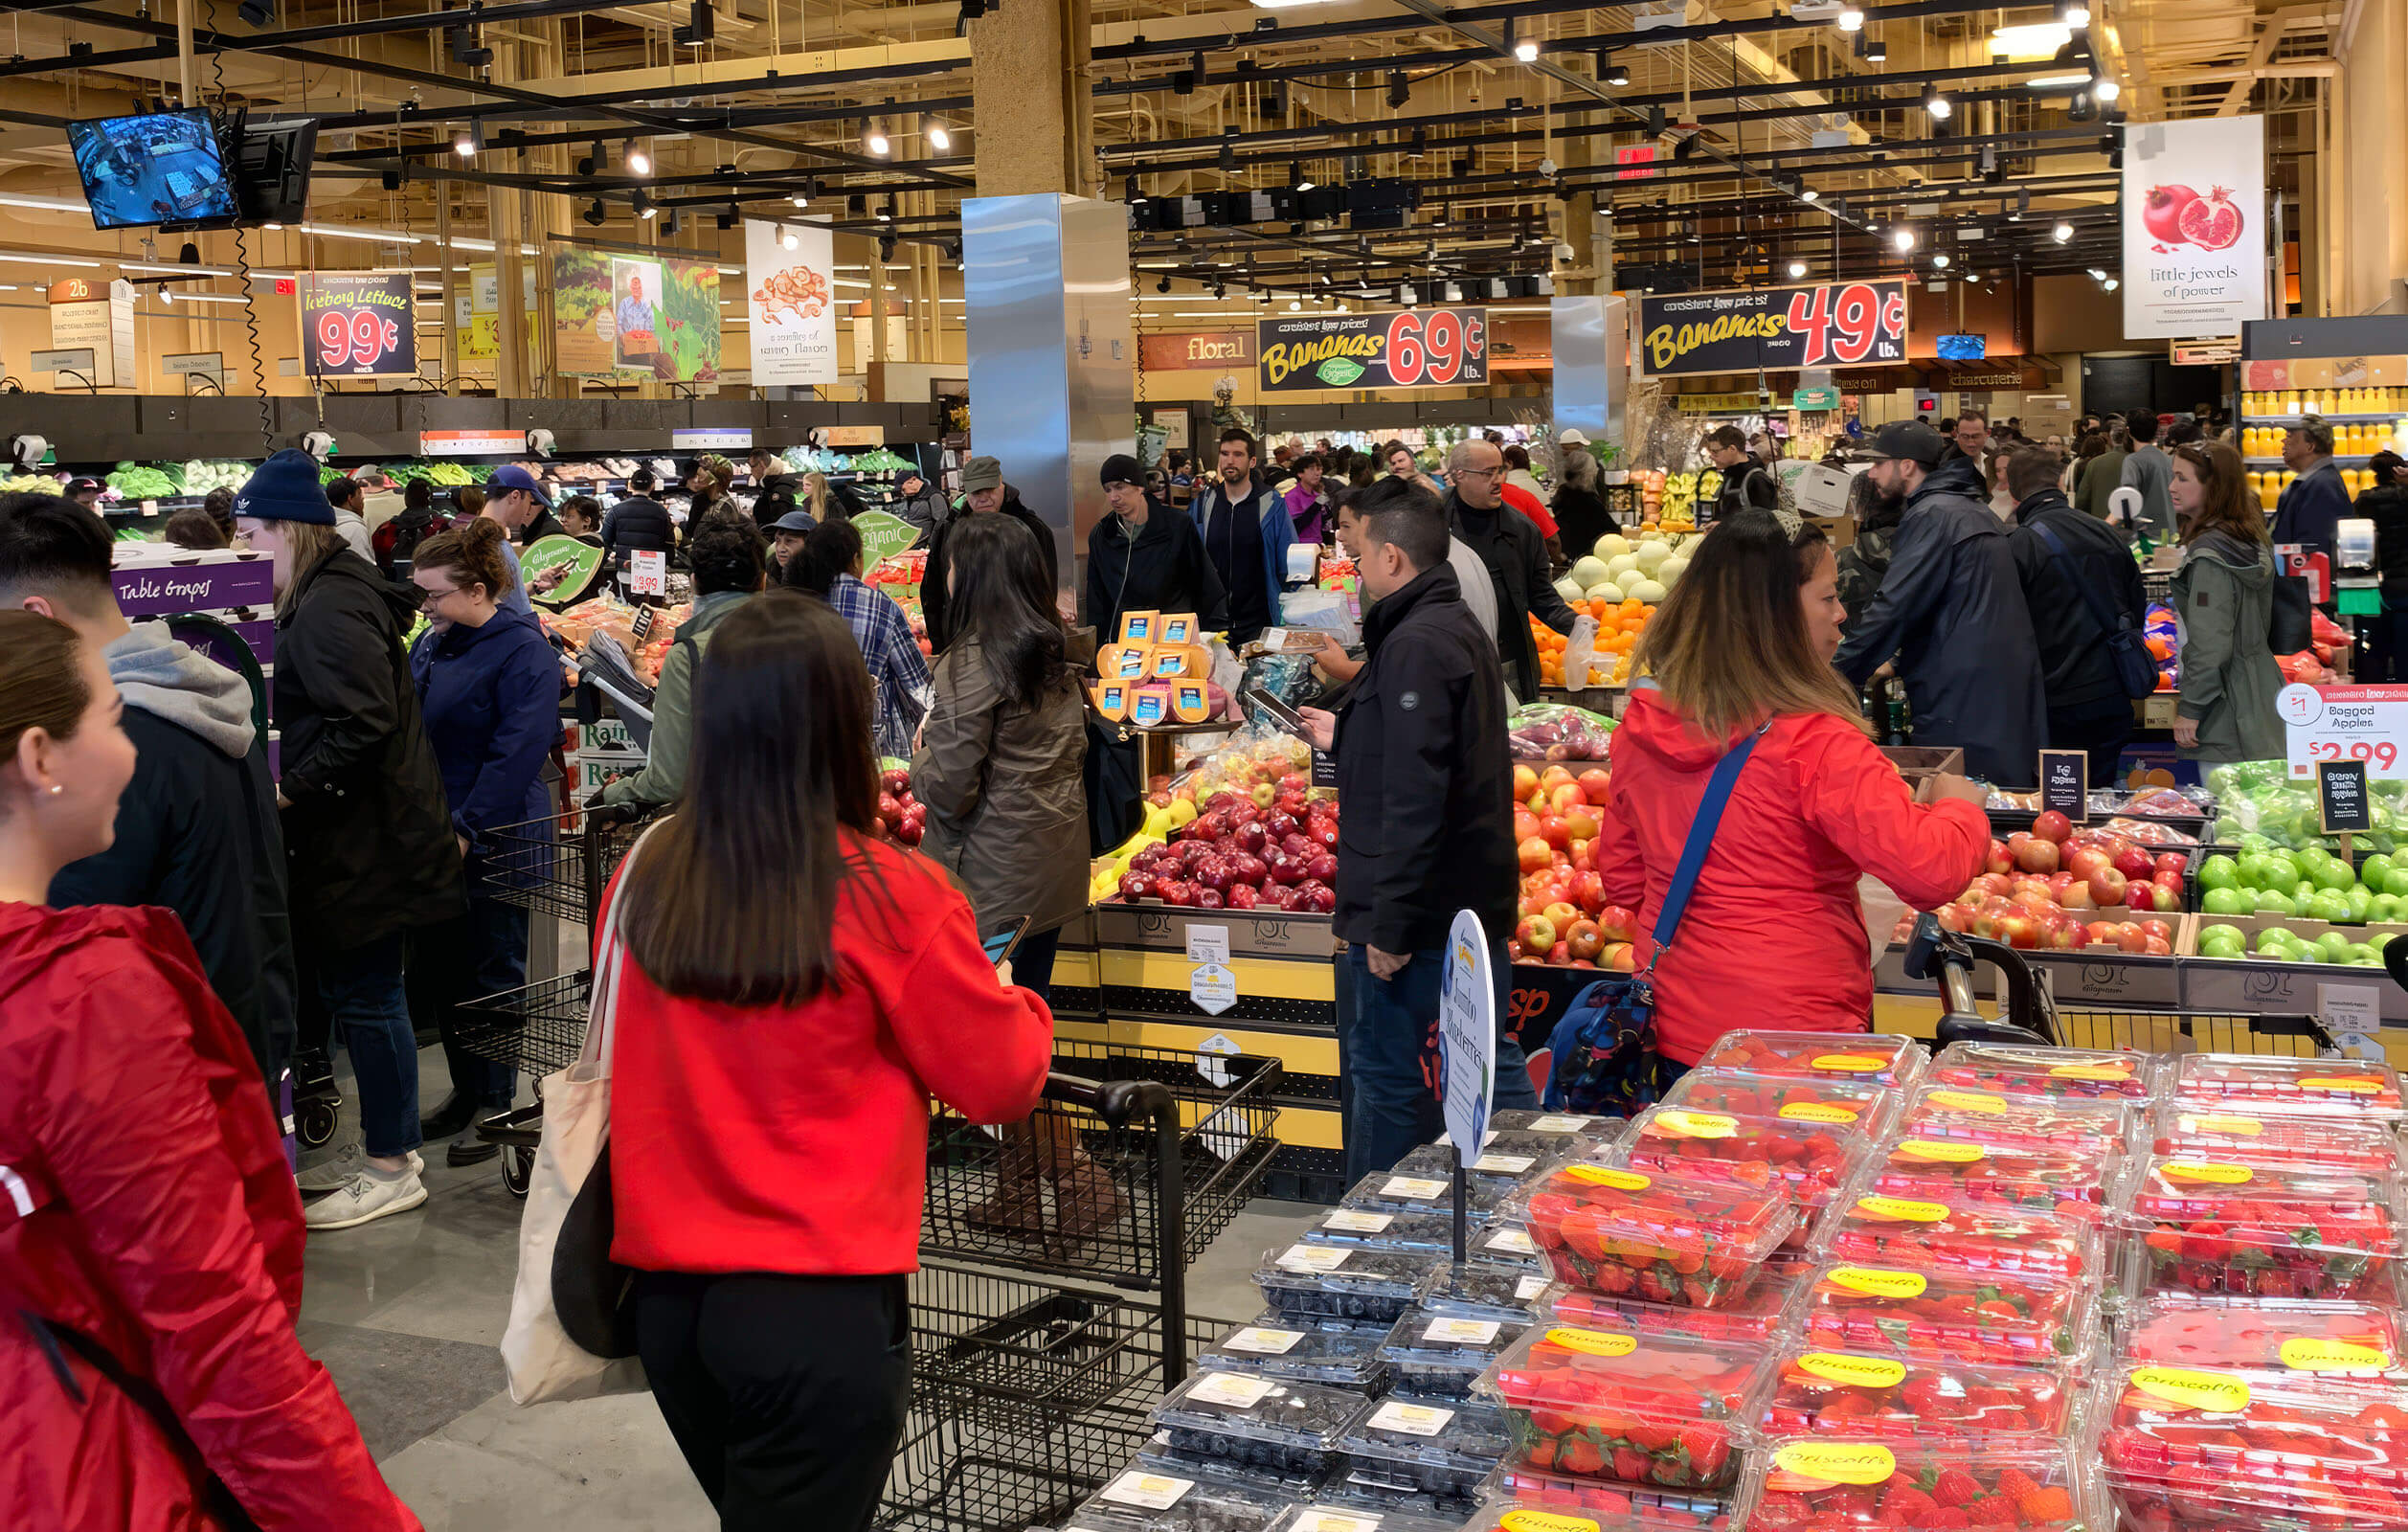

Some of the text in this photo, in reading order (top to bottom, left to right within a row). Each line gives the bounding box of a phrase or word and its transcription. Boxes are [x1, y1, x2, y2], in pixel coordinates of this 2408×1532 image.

[2150, 264, 2238, 282] little jewels
[357, 287, 407, 309] Lettuce
[2164, 285, 2225, 299] of power
[1187, 336, 1246, 360] floral
[1644, 312, 1787, 370] Bananas
[1261, 333, 1385, 385] Bananas
[120, 577, 213, 603] Table Grapes
